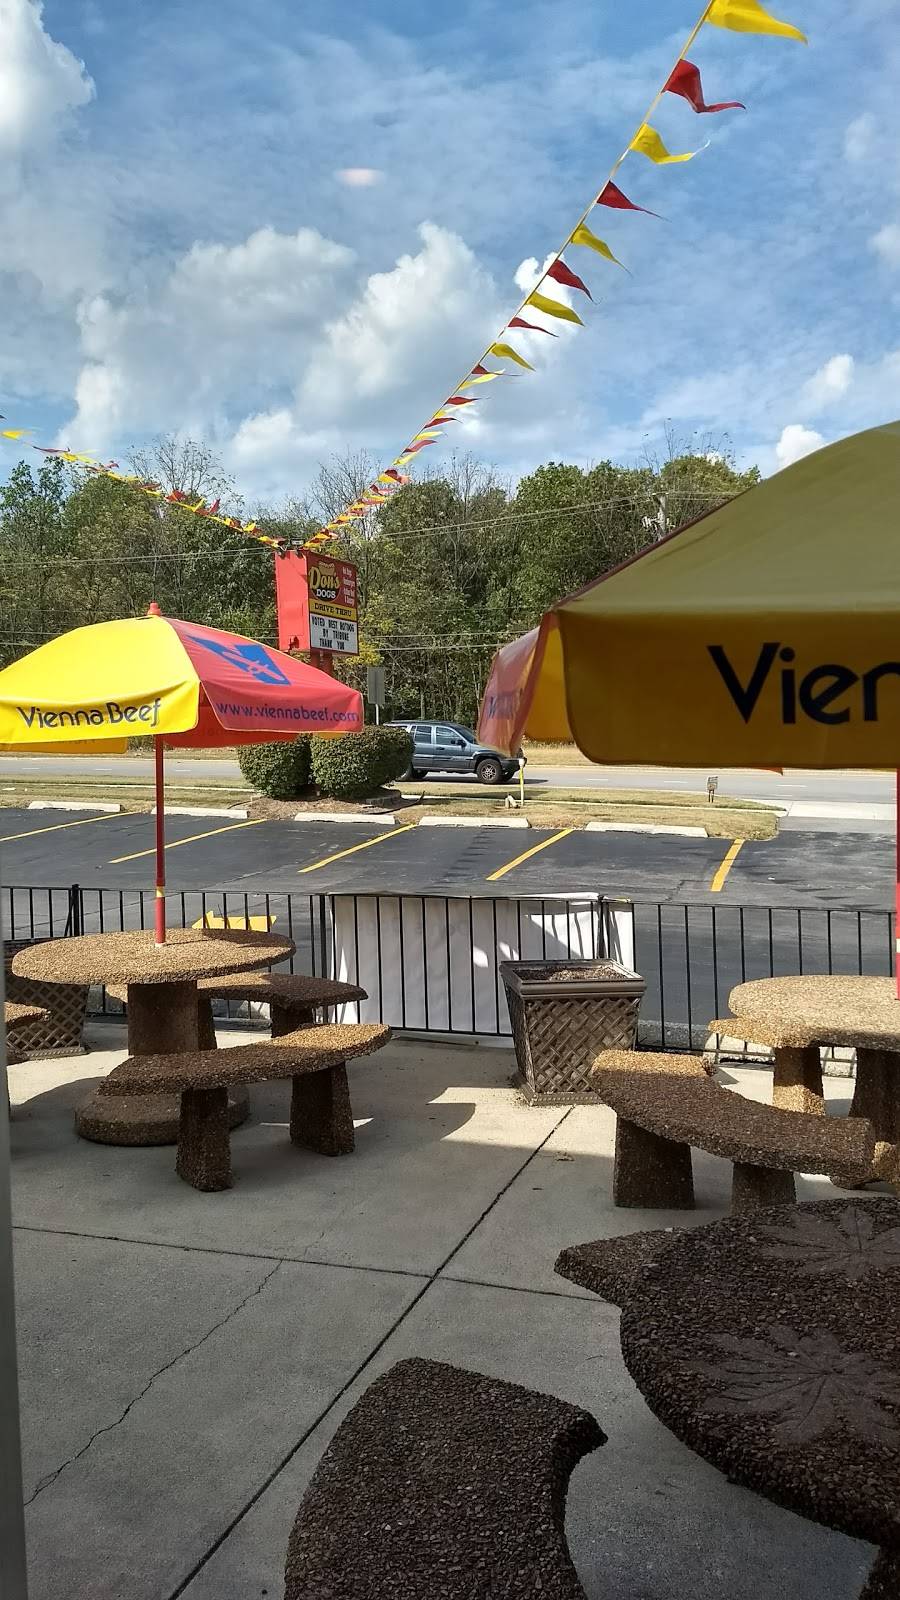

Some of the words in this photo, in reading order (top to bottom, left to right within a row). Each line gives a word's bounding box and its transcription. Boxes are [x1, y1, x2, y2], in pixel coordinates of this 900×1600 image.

[308, 566, 341, 590] Don's
[316, 588, 336, 599] DOGS
[311, 616, 326, 627] VOTED
[328, 619, 338, 630] BEST
[322, 628, 329, 638] BY
[332, 630, 349, 641] TRIBUNE
[319, 638, 333, 649] THANK
[336, 640, 345, 650] YOU
[16, 706, 105, 729] Vienna
[105, 697, 162, 728] Beef
[216, 701, 360, 723] www.viennabeef.com
